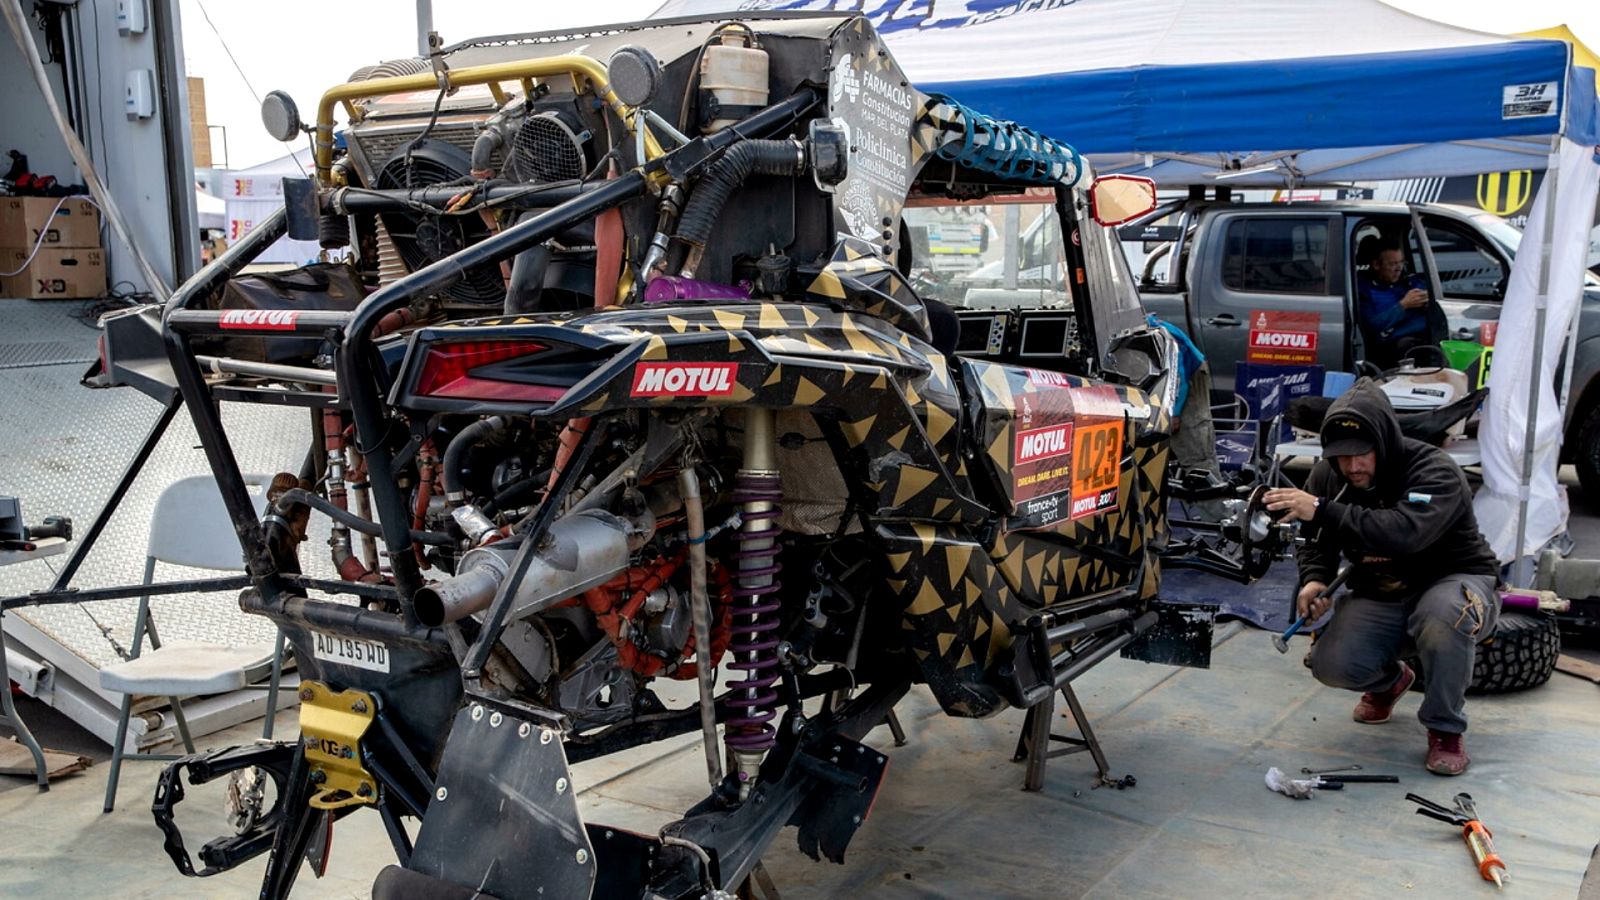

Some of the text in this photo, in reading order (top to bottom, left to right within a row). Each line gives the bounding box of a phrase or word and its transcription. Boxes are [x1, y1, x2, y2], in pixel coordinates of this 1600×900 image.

[863, 70, 912, 110] FARMACIAS
[1515, 84, 1548, 97] 3H
[862, 91, 911, 127] Constitución
[861, 108, 909, 142] MAR DEL PLATA
[855, 127, 907, 169] Policlínica
[856, 149, 906, 186] Constitución
[223, 310, 292, 325] MOTUL
[1256, 333, 1309, 347] MOTUL
[636, 367, 730, 392] MOTUL
[1030, 368, 1067, 384] MOTUL
[1021, 427, 1118, 491] MOTUL 423
[1041, 509, 1058, 524] sport
[1073, 497, 1096, 513] MOTUL
[318, 634, 386, 665] AD 195 WD
